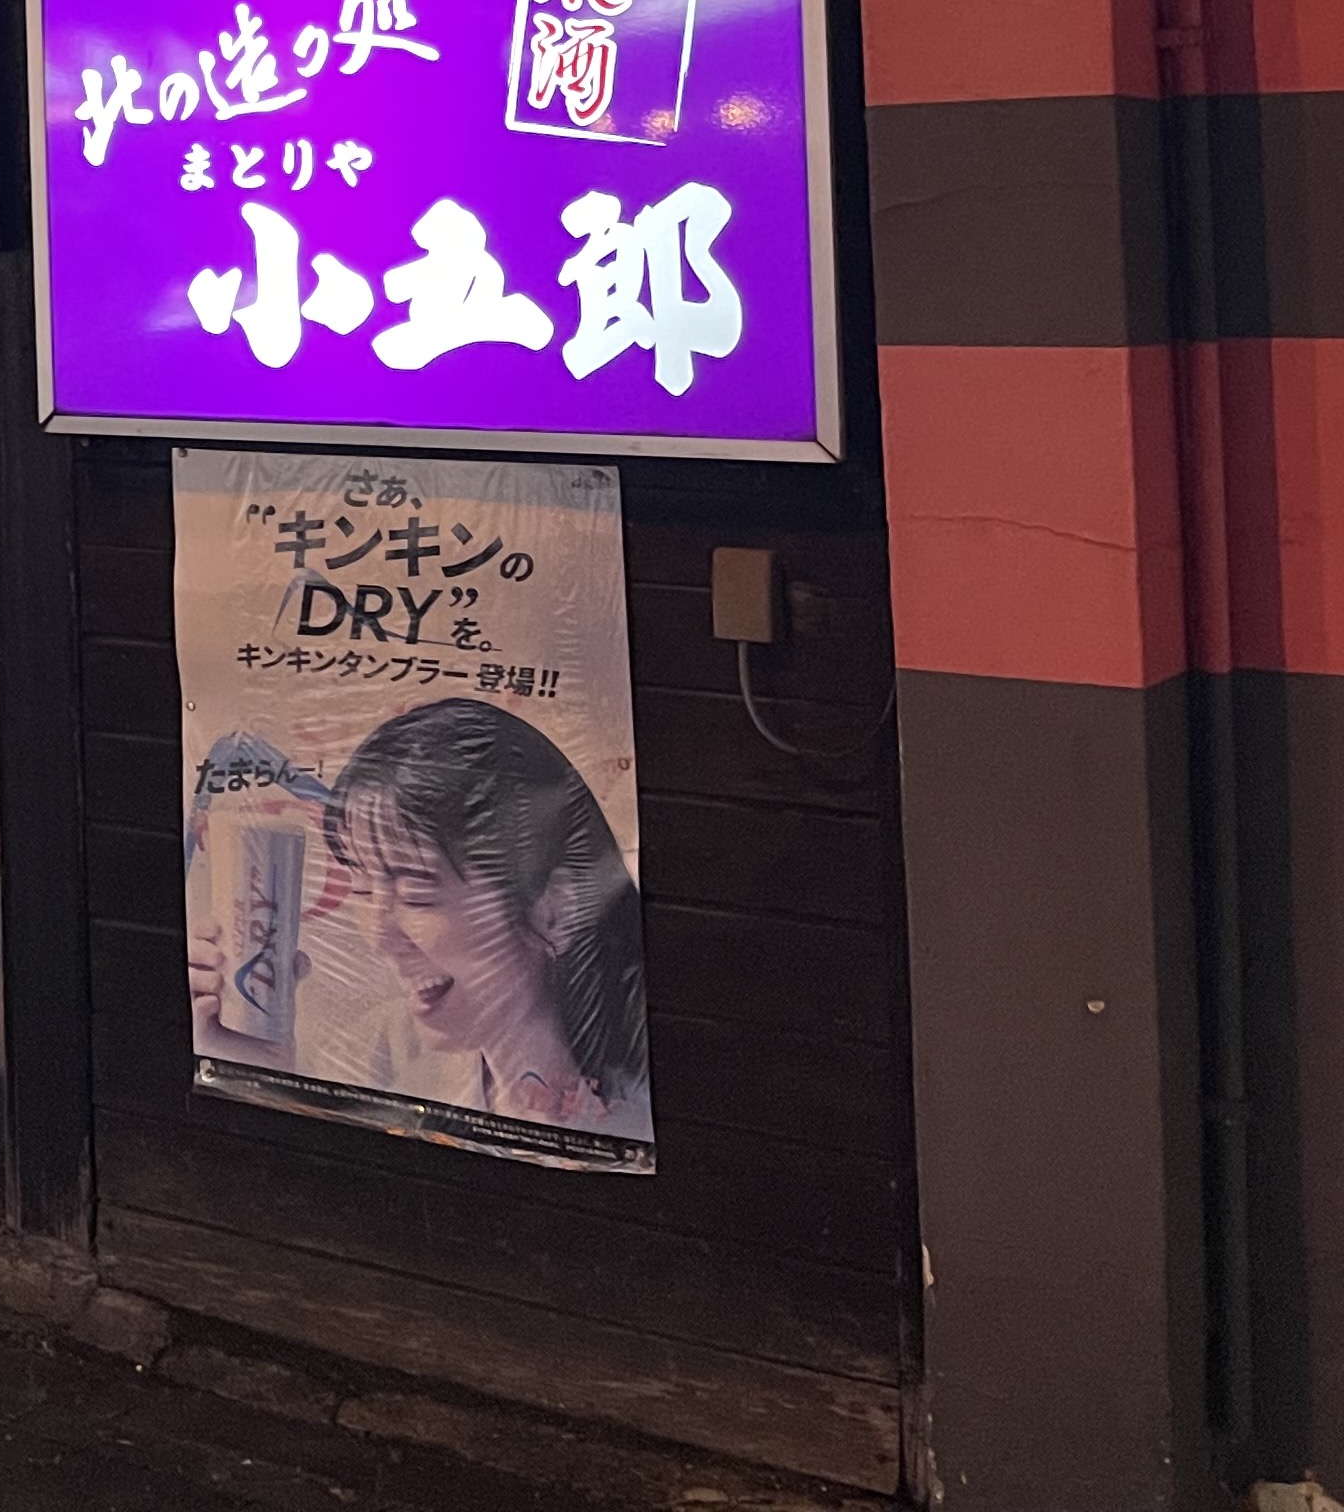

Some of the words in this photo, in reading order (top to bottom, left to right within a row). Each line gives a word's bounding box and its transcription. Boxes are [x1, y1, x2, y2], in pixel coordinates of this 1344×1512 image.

[180, 140, 373, 192] まとりや
[187, 182, 743, 396] 小五郎
[344, 469, 424, 509] さあ、
